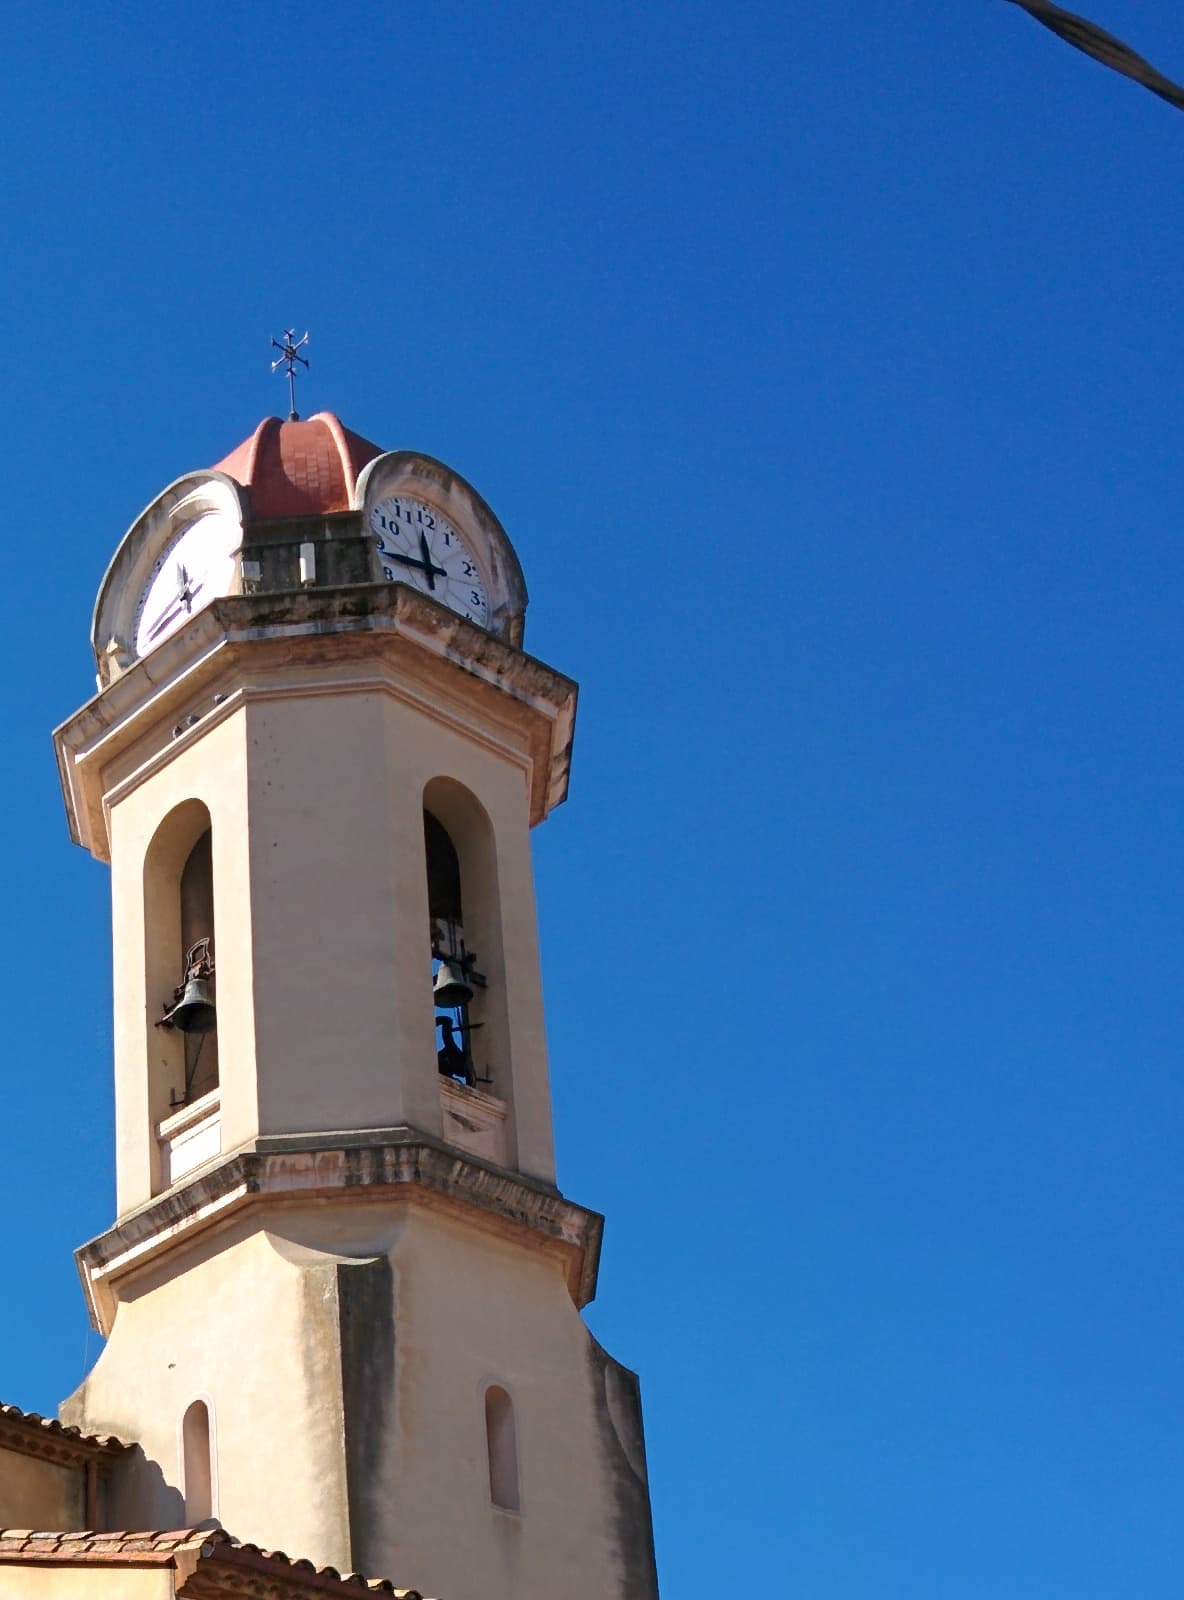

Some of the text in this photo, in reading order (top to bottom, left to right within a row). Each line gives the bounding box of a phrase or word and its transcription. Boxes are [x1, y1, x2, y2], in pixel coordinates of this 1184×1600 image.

[395, 504, 412, 524] 11
[417, 510, 435, 531] 12
[381, 515, 400, 536] 10
[443, 532, 452, 547] 1
[461, 560, 473, 577] 2
[470, 590, 481, 606] 3
